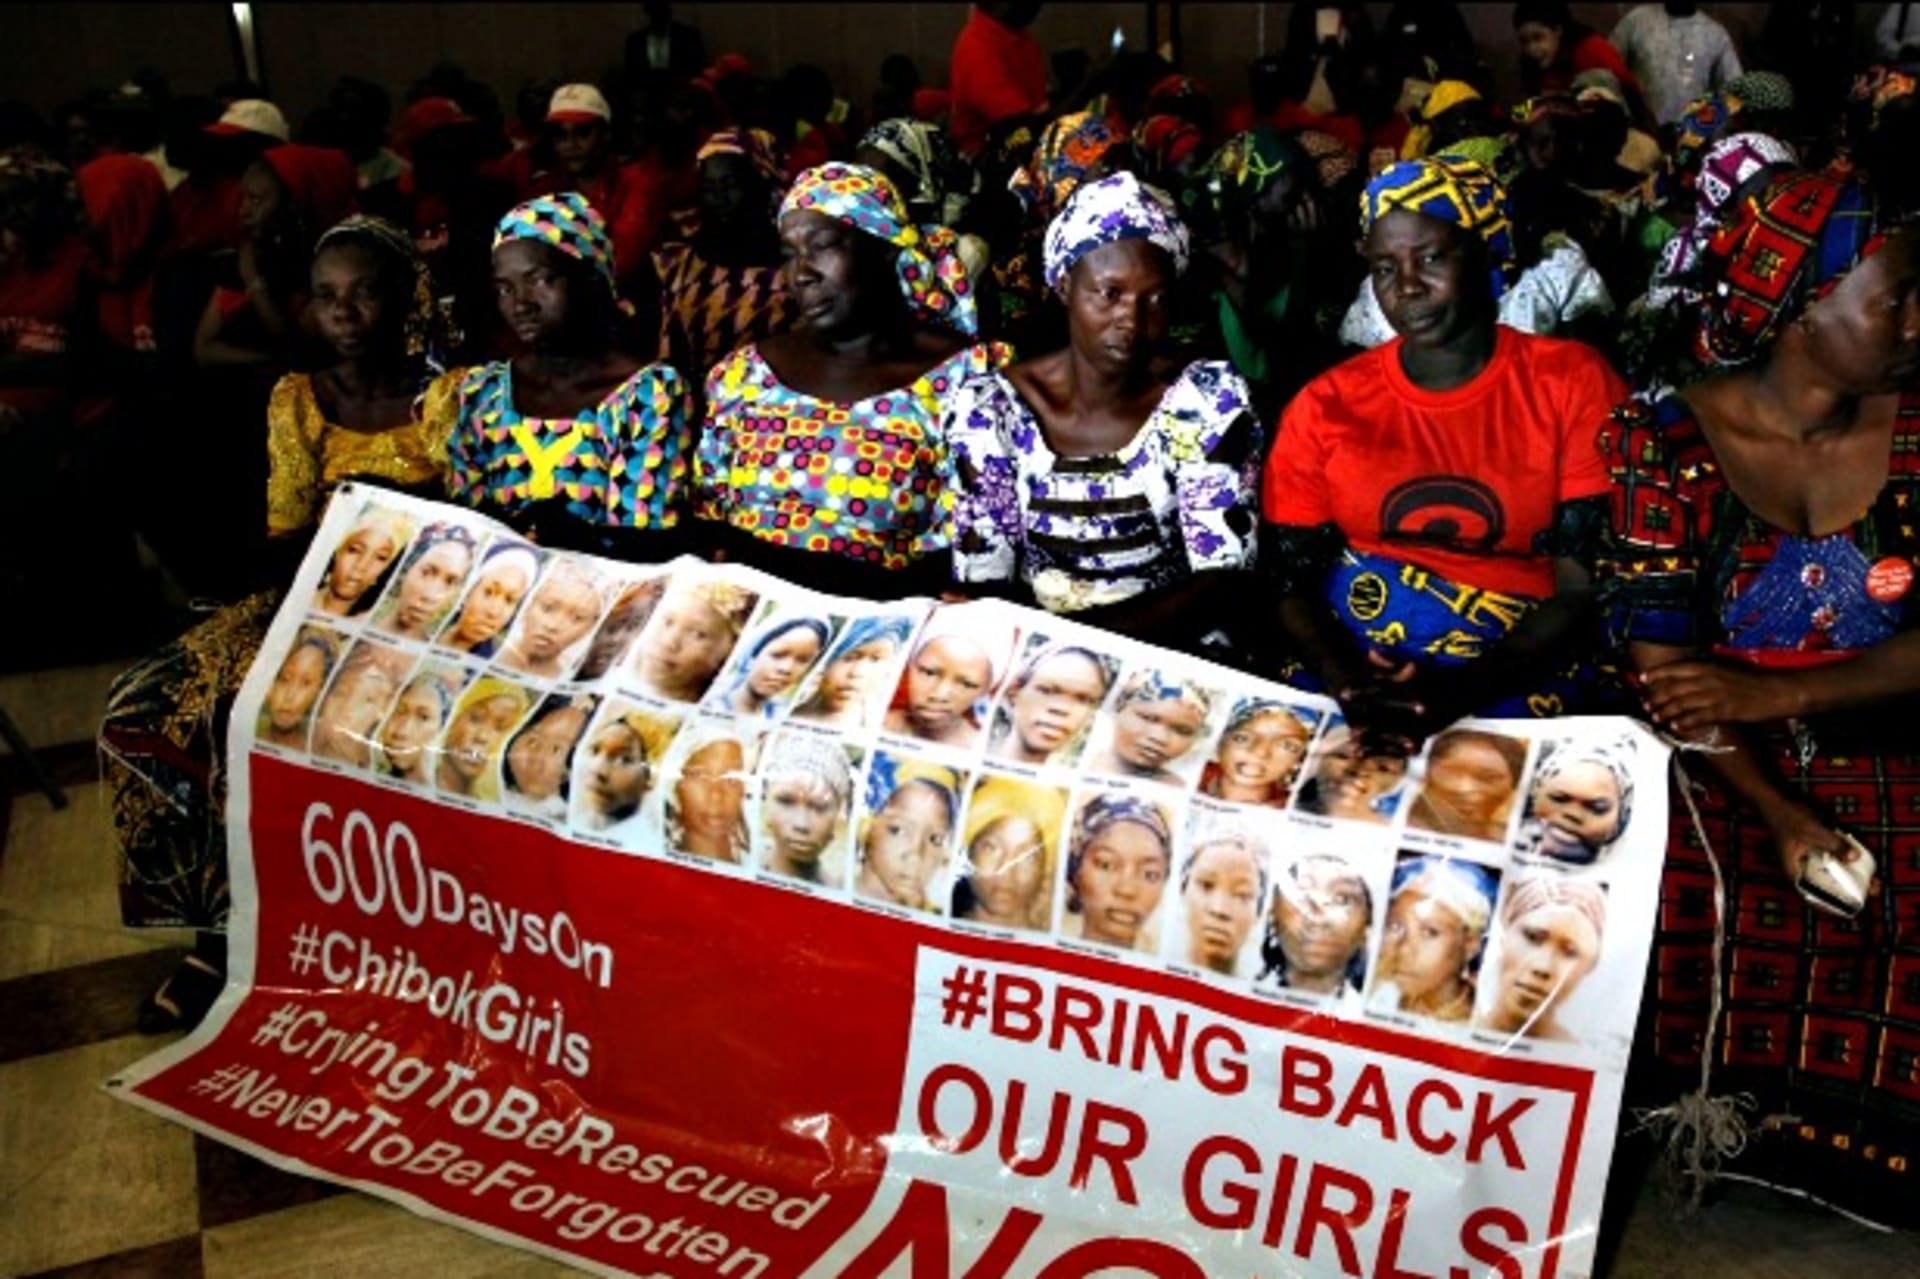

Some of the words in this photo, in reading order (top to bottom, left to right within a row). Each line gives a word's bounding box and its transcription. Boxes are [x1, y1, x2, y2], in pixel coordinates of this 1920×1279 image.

[289, 923, 591, 1078] #ChibokGirls
[941, 964, 1250, 1096] #BRING
[1279, 1045, 1538, 1170] BACK
[196, 1064, 770, 1279] #NeverToBeForgotten
[252, 1001, 832, 1231] #CryingToBeRescued
[916, 1063, 1148, 1206] OUR
[1182, 1136, 1531, 1279] GIRLS
